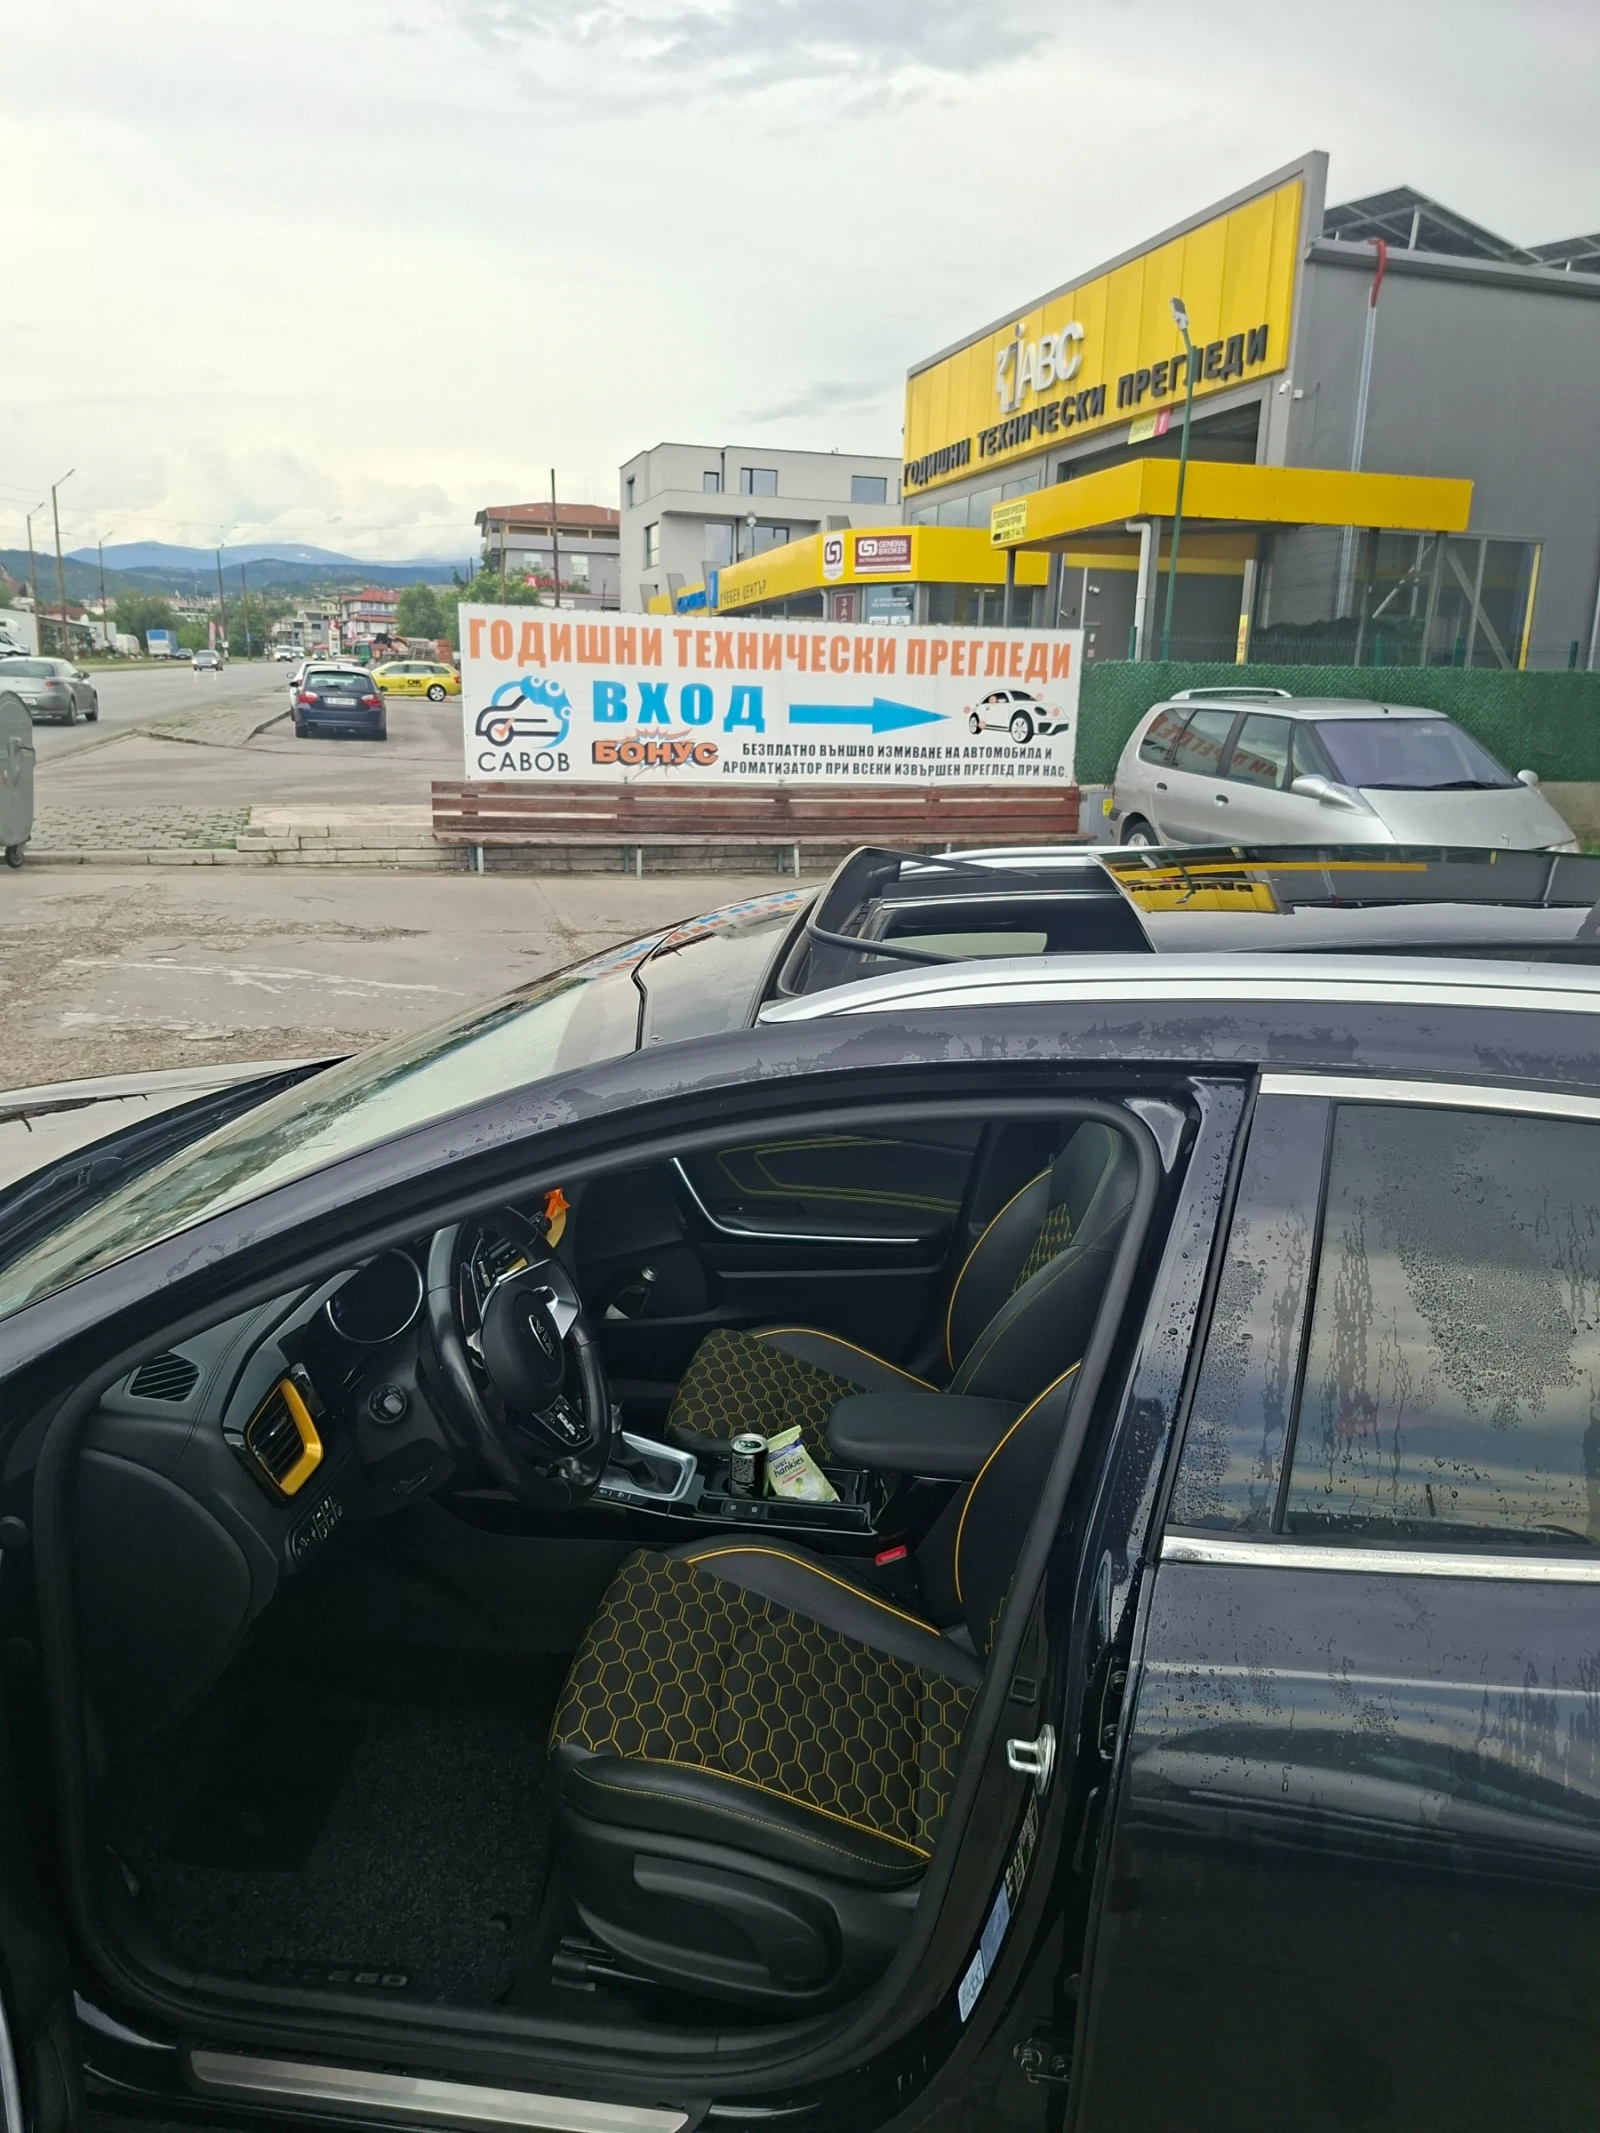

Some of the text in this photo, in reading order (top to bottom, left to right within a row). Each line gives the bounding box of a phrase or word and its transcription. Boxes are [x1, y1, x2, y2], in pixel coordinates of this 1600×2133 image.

[904, 324, 1268, 487] ГОДИШНИ ТЕХНИЧЕСКИ ПРЕГЛЕДИ
[468, 618, 1071, 684] ГОДИШНИ ТЕХНИЧЕСКИ ПРЕГЛЕДИ
[592, 680, 766, 733] ВХОД
[477, 751, 571, 773] САВОВ
[592, 740, 719, 767] БОНУС
[742, 743, 1052, 760] БЕЗПЛАТНО ВЪНШНО ИЗМИВАНЕ НА АВТОМОБИЛА И
[722, 761, 1068, 778] АРОМАТИЗАТОР ПРИ ВСЕКИ ИЗВЪРШЕН ПРЕГЛЕД ПРИ НАС.
[773, 1457, 805, 1478] hankies
